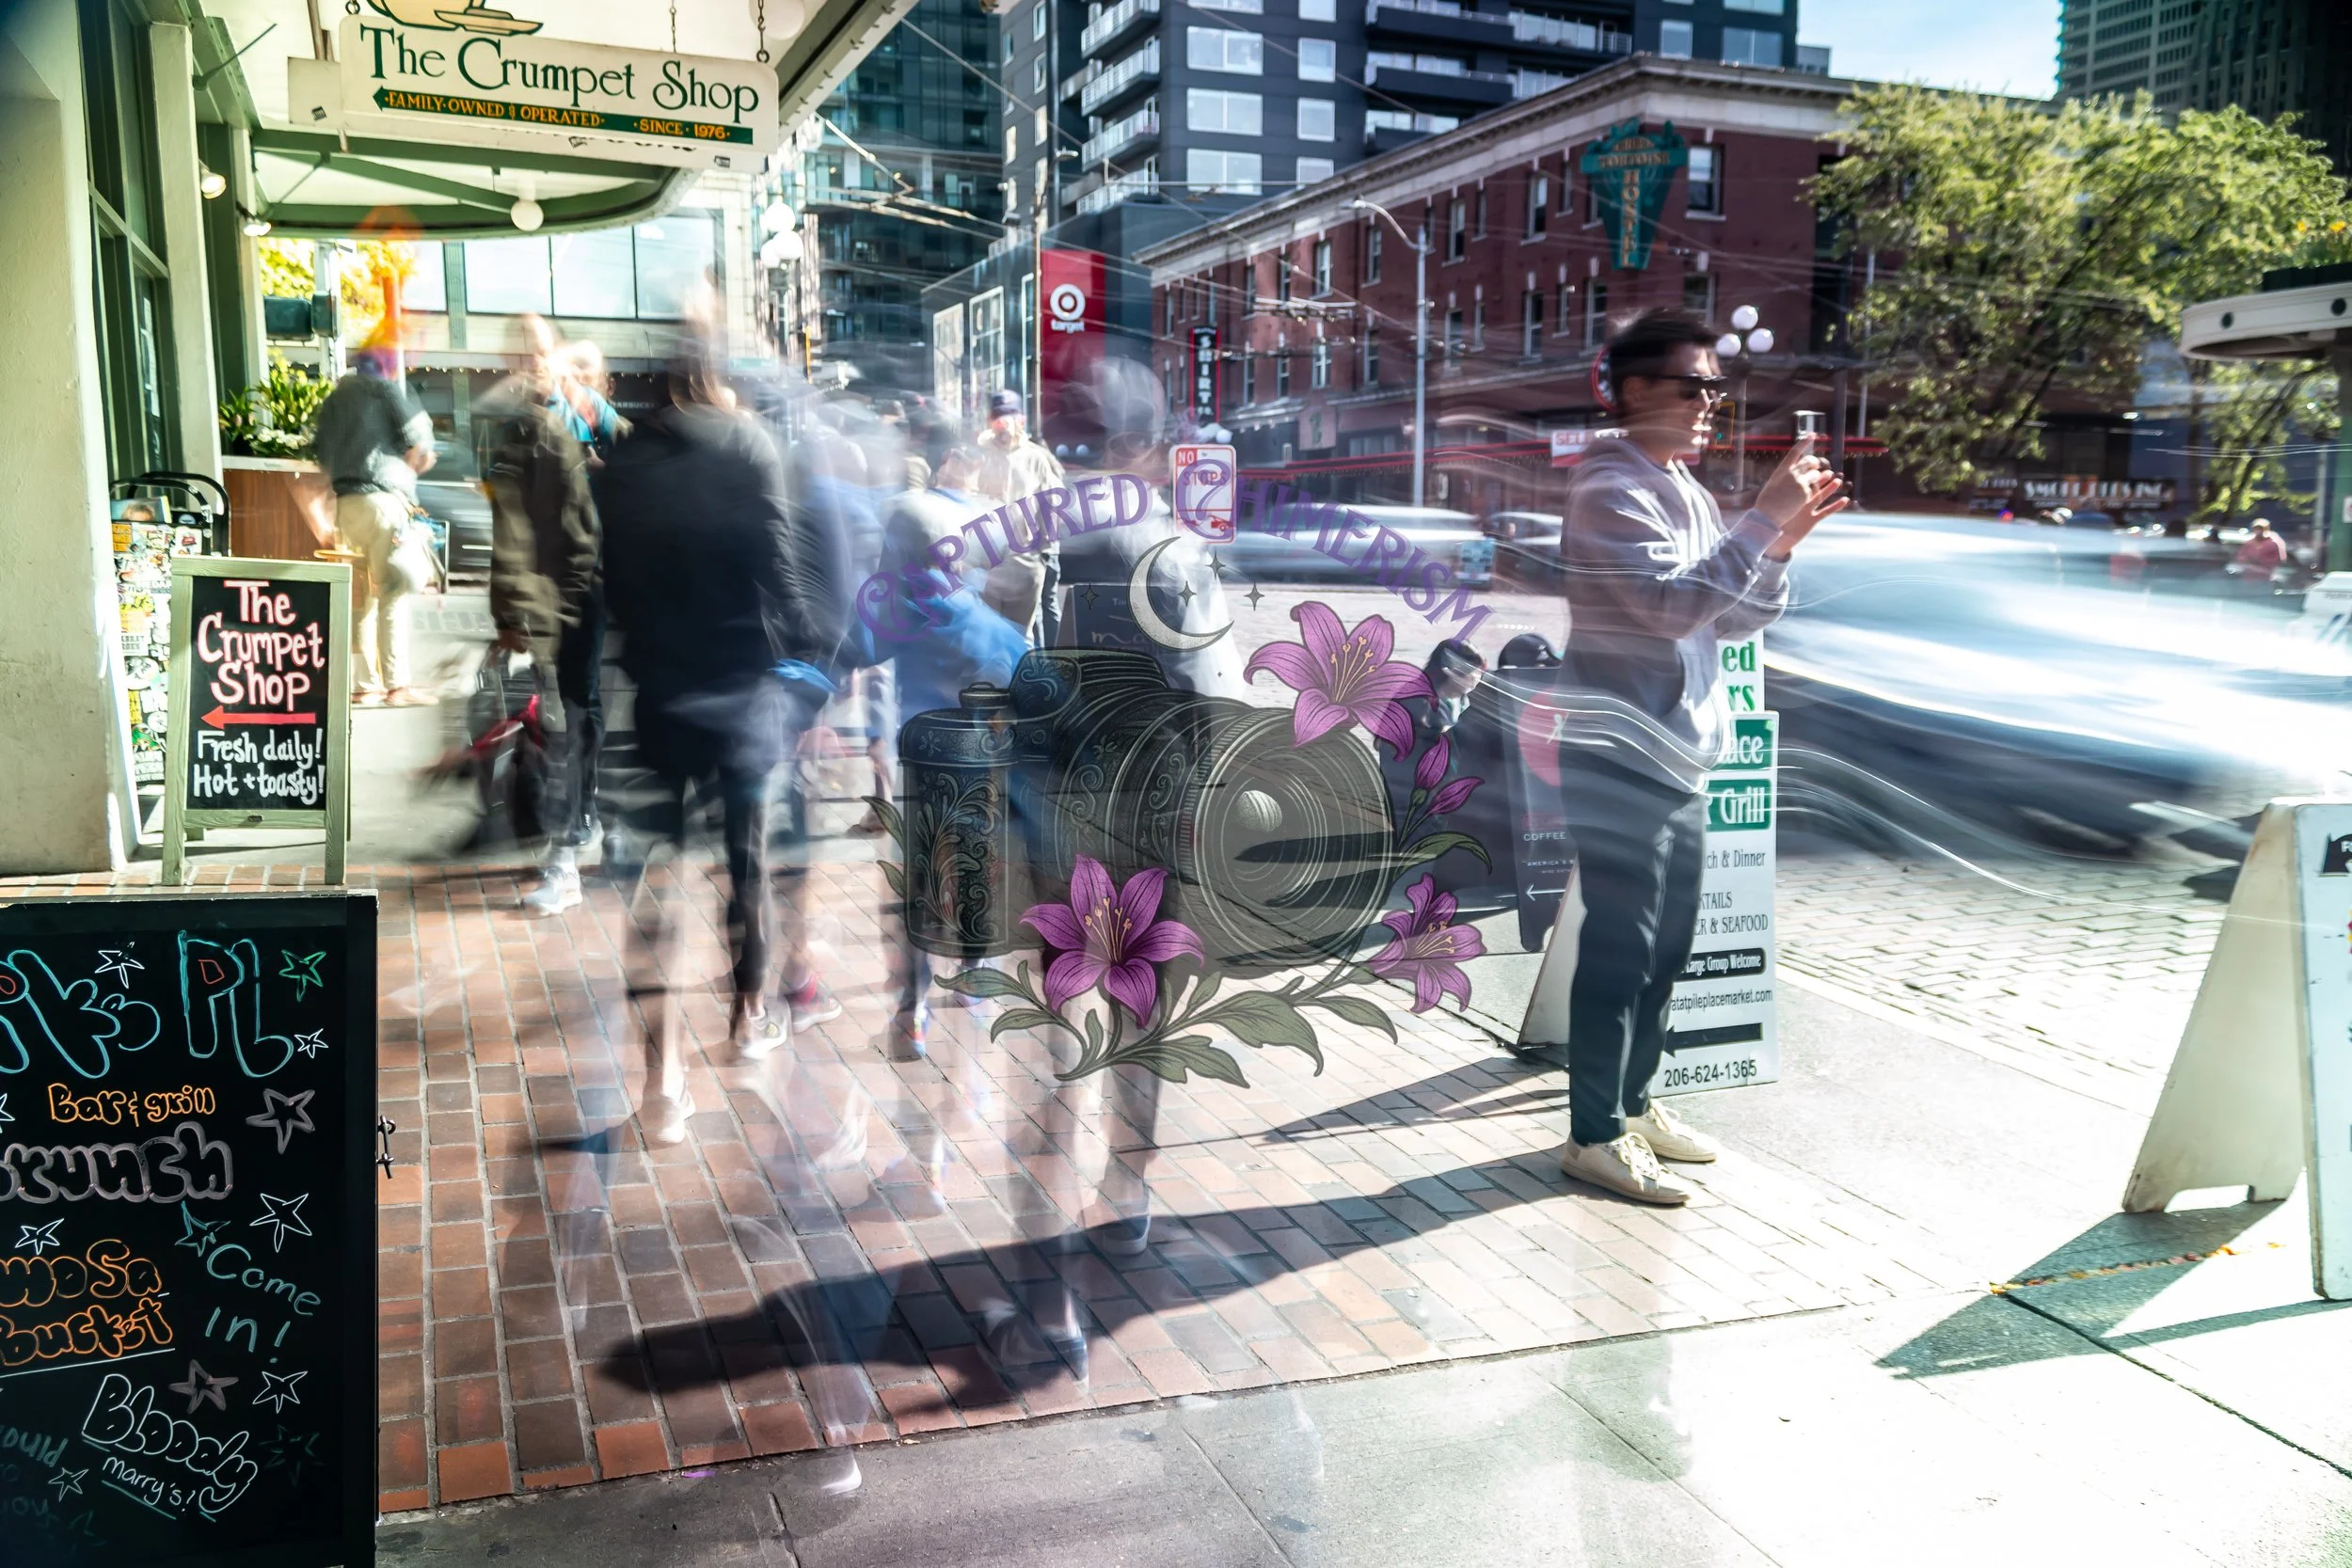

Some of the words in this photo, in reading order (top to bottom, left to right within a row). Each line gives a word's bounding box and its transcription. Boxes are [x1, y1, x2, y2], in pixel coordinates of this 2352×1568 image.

[360, 23, 446, 80] The
[458, 38, 637, 108] Crumpet
[653, 60, 759, 123] Shop
[520, 106, 600, 127] OPERATED
[640, 119, 683, 135] SINCE
[693, 124, 727, 139] 1976
[1622, 169, 1641, 268] HOSTEL
[1178, 451, 1195, 464] NO
[224, 580, 297, 626] The
[197, 612, 326, 669] Crumpet
[1723, 641, 1756, 673] ed
[211, 661, 310, 711] Shop
[1727, 684, 1755, 712] rs
[197, 730, 258, 763] Fresh
[263, 730, 323, 770] daily!
[194, 765, 239, 798] Hot
[1720, 785, 1765, 826] Grill
[1523, 832, 1565, 841] COFFEE
[1706, 850, 1718, 869] ch
[1722, 850, 1730, 868] &
[1734, 848, 1766, 867] Dinner
[1699, 892, 1733, 910] KTAILS
[1710, 918, 1719, 934] &
[1722, 913, 1769, 933] SEAFOOD
[1708, 956, 1728, 974] Group
[1730, 954, 1761, 970] Welcome
[1664, 1059, 1757, 1087] 206-624-1365
[48, 1083, 127, 1125] Bar
[206, 1243, 321, 1316] Come
[0, 1426, 69, 1468] ould
[82, 1373, 258, 1513] Bloody
